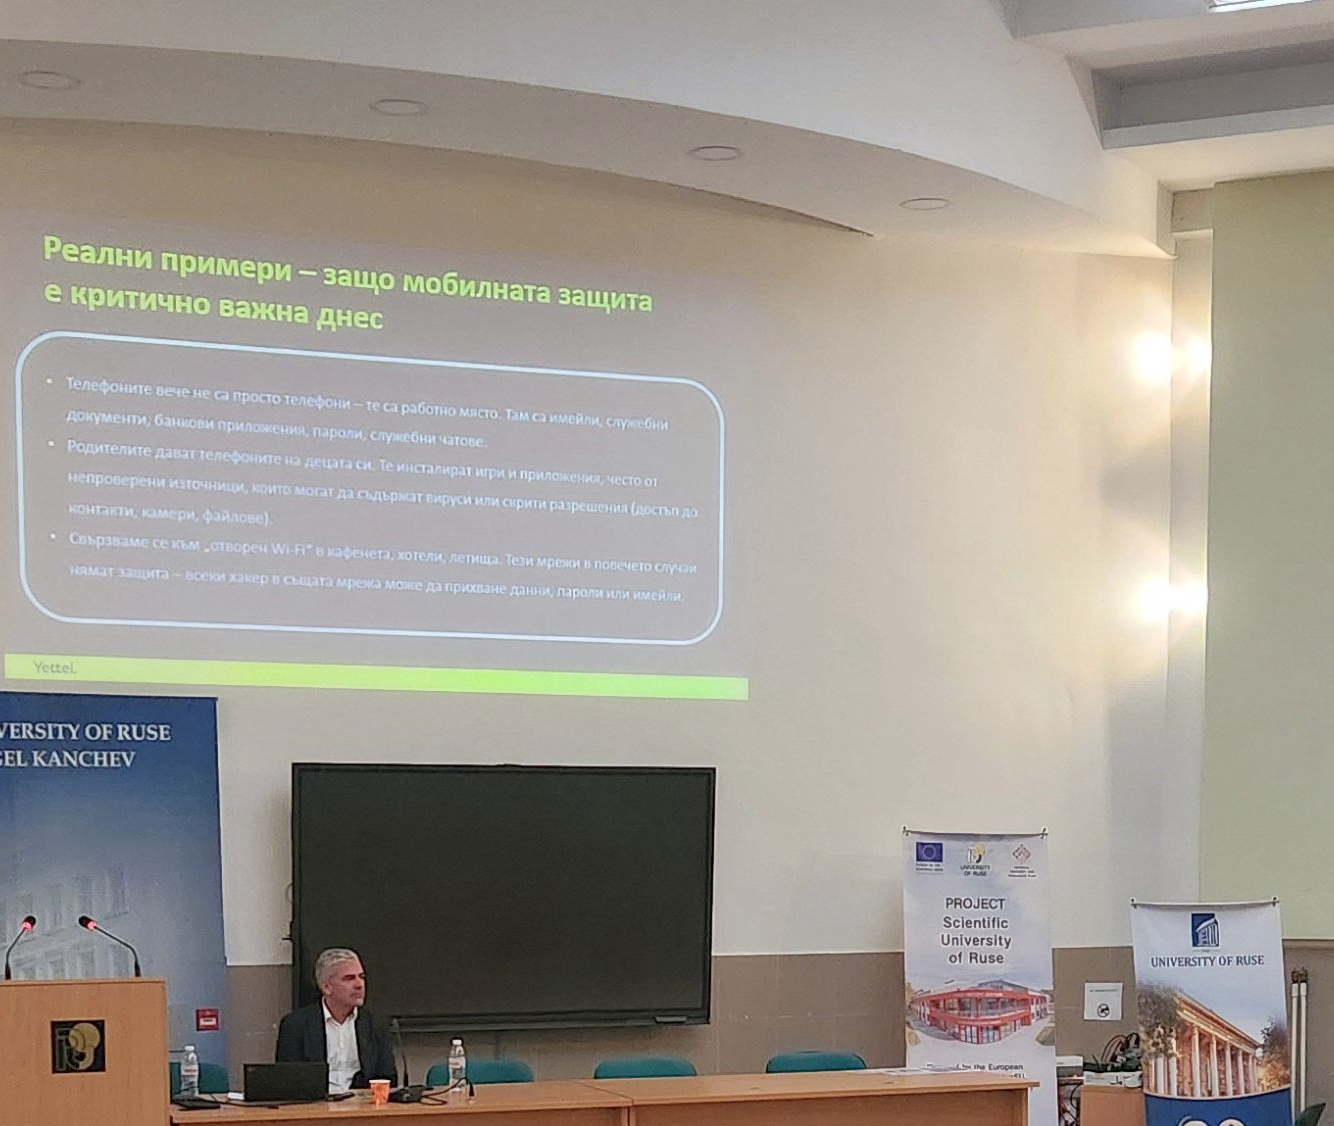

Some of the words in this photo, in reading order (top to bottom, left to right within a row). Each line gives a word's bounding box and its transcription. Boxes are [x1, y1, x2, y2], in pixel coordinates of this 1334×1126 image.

[43, 234, 152, 269] Реални
[161, 250, 292, 284] примери
[323, 266, 395, 295] защо
[403, 271, 550, 303] мобилната
[558, 286, 653, 314] защита
[44, 282, 62, 302] е
[71, 284, 211, 315] критично
[219, 297, 308, 324] важна
[316, 307, 384, 331] днес
[66, 376, 152, 396] Телефоните
[156, 386, 190, 398] вече
[194, 388, 210, 399] не
[214, 390, 229, 400] са
[233, 391, 281, 405] просто
[284, 394, 351, 411] телефони
[367, 401, 380, 412] те
[383, 402, 398, 413] са
[401, 402, 456, 418] работно
[505, 407, 529, 422] Там
[532, 412, 547, 423] са
[606, 416, 669, 432] служебни
[67, 409, 151, 428] документи,
[154, 413, 214, 430] банкови
[218, 420, 310, 437] приложения,
[313, 426, 367, 442] пароли,
[370, 430, 436, 446] служебни
[67, 438, 152, 457] Родителите
[155, 447, 195, 460] дават
[200, 450, 281, 466] телефоните
[285, 457, 301, 467] на
[304, 458, 352, 471] децата
[379, 458, 393, 471] Те
[397, 463, 472, 479] инсталират
[475, 467, 505, 481] игри
[508, 469, 517, 479] и
[520, 469, 604, 486] приложения,
[607, 475, 641, 487] често
[644, 477, 659, 488] от
[68, 472, 166, 491] непроверени
[169, 479, 248, 495] източници,
[295, 487, 334, 499] могат
[337, 489, 354, 500] да
[357, 489, 424, 505] съдържат
[426, 494, 472, 509] вируси
[475, 496, 500, 507] или
[502, 498, 547, 512] скрити
[549, 499, 628, 514] разрешения
[682, 508, 698, 519] до
[69, 503, 139, 520] контакти,
[142, 507, 199, 522] камери,
[69, 531, 149, 549] Свързваме
[153, 539, 168, 549] се
[172, 539, 200, 551] към
[316, 546, 324, 556] в
[506, 553, 534, 568] Тези
[537, 558, 580, 571] мрежи
[583, 559, 591, 569] в
[594, 560, 652, 573] повечето
[70, 563, 114, 578] нямат
[119, 566, 170, 581] защита
[186, 570, 226, 582] всеки
[229, 571, 268, 586] хакер
[283, 574, 333, 589] същата
[336, 577, 382, 591] мрежа
[385, 579, 422, 591] може
[426, 581, 442, 593] да
[557, 587, 603, 600] пароли
[607, 589, 629, 600] или
[84, 722, 113, 741] OF
[117, 722, 171, 742] RUSE
[33, 750, 136, 768] KANCHEV
[945, 897, 1006, 910] PROJECT
[943, 916, 1009, 929] Scientific
[941, 934, 1012, 949] University
[948, 951, 963, 964] of
[969, 952, 1004, 964] Ruse
[1151, 956, 1216, 968] UNIVERSITY
[1218, 956, 1233, 966] OF
[1236, 955, 1265, 965] RUSE
[988, 1063, 1024, 1072] European
